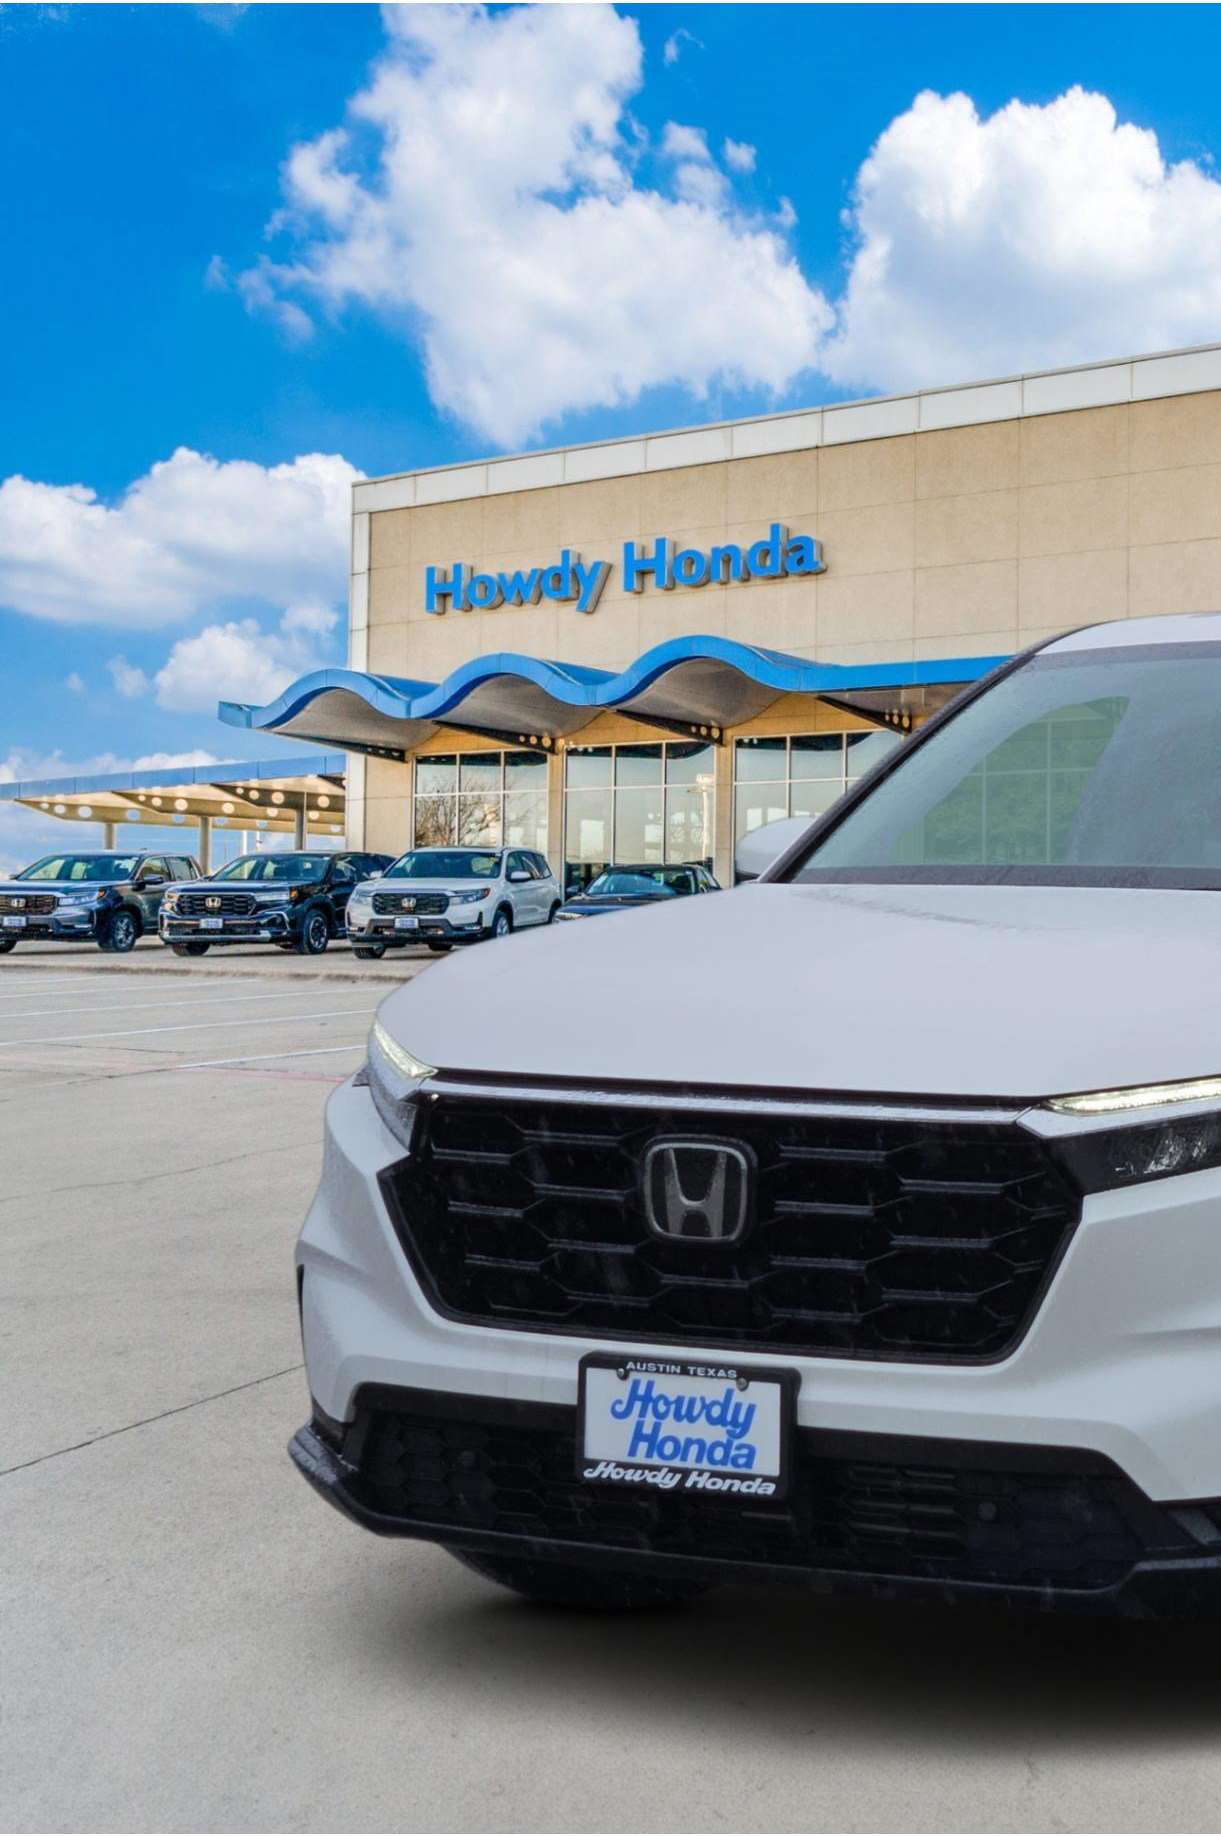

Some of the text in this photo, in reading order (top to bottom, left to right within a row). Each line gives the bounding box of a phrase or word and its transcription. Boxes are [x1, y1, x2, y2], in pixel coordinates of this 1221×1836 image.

[424, 522, 826, 614] Howdy Honda
[626, 1361, 738, 1379] AUSTIN TEXAS
[609, 1377, 758, 1441] Howdy
[626, 1418, 758, 1471] Honda
[582, 1460, 777, 1496] Howdy Honda
